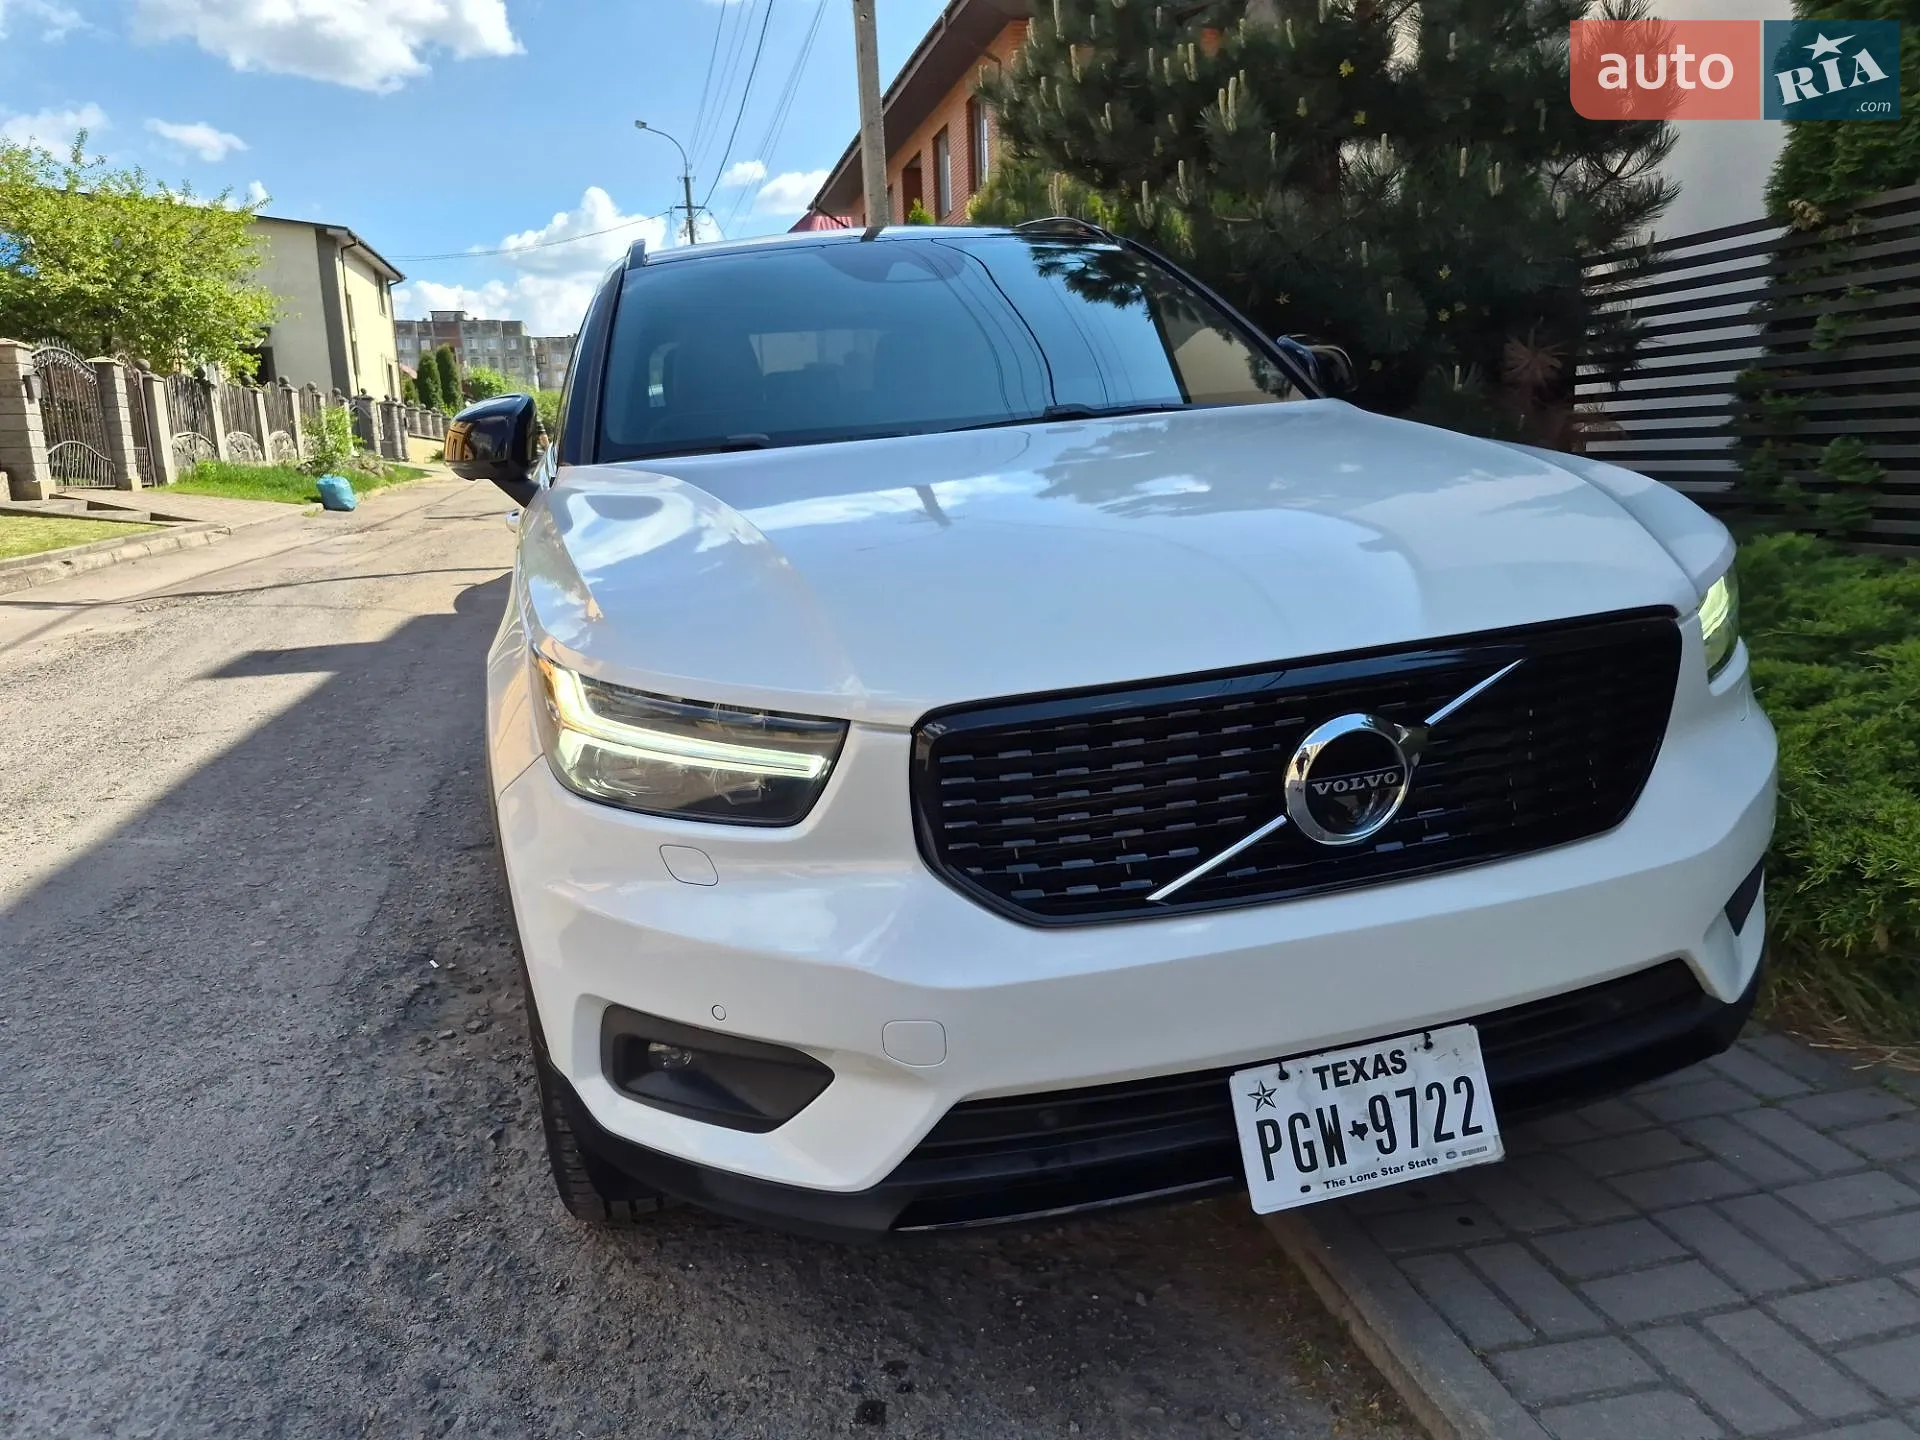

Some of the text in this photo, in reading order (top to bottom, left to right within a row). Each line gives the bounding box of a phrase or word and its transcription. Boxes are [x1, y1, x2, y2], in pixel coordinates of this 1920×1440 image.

[1312, 771, 1398, 795] VOLVO
[1312, 1049, 1408, 1091] TEXAS
[1256, 1075, 1483, 1182] PGW 9722
[1323, 1157, 1438, 1189] The Lone Star State
